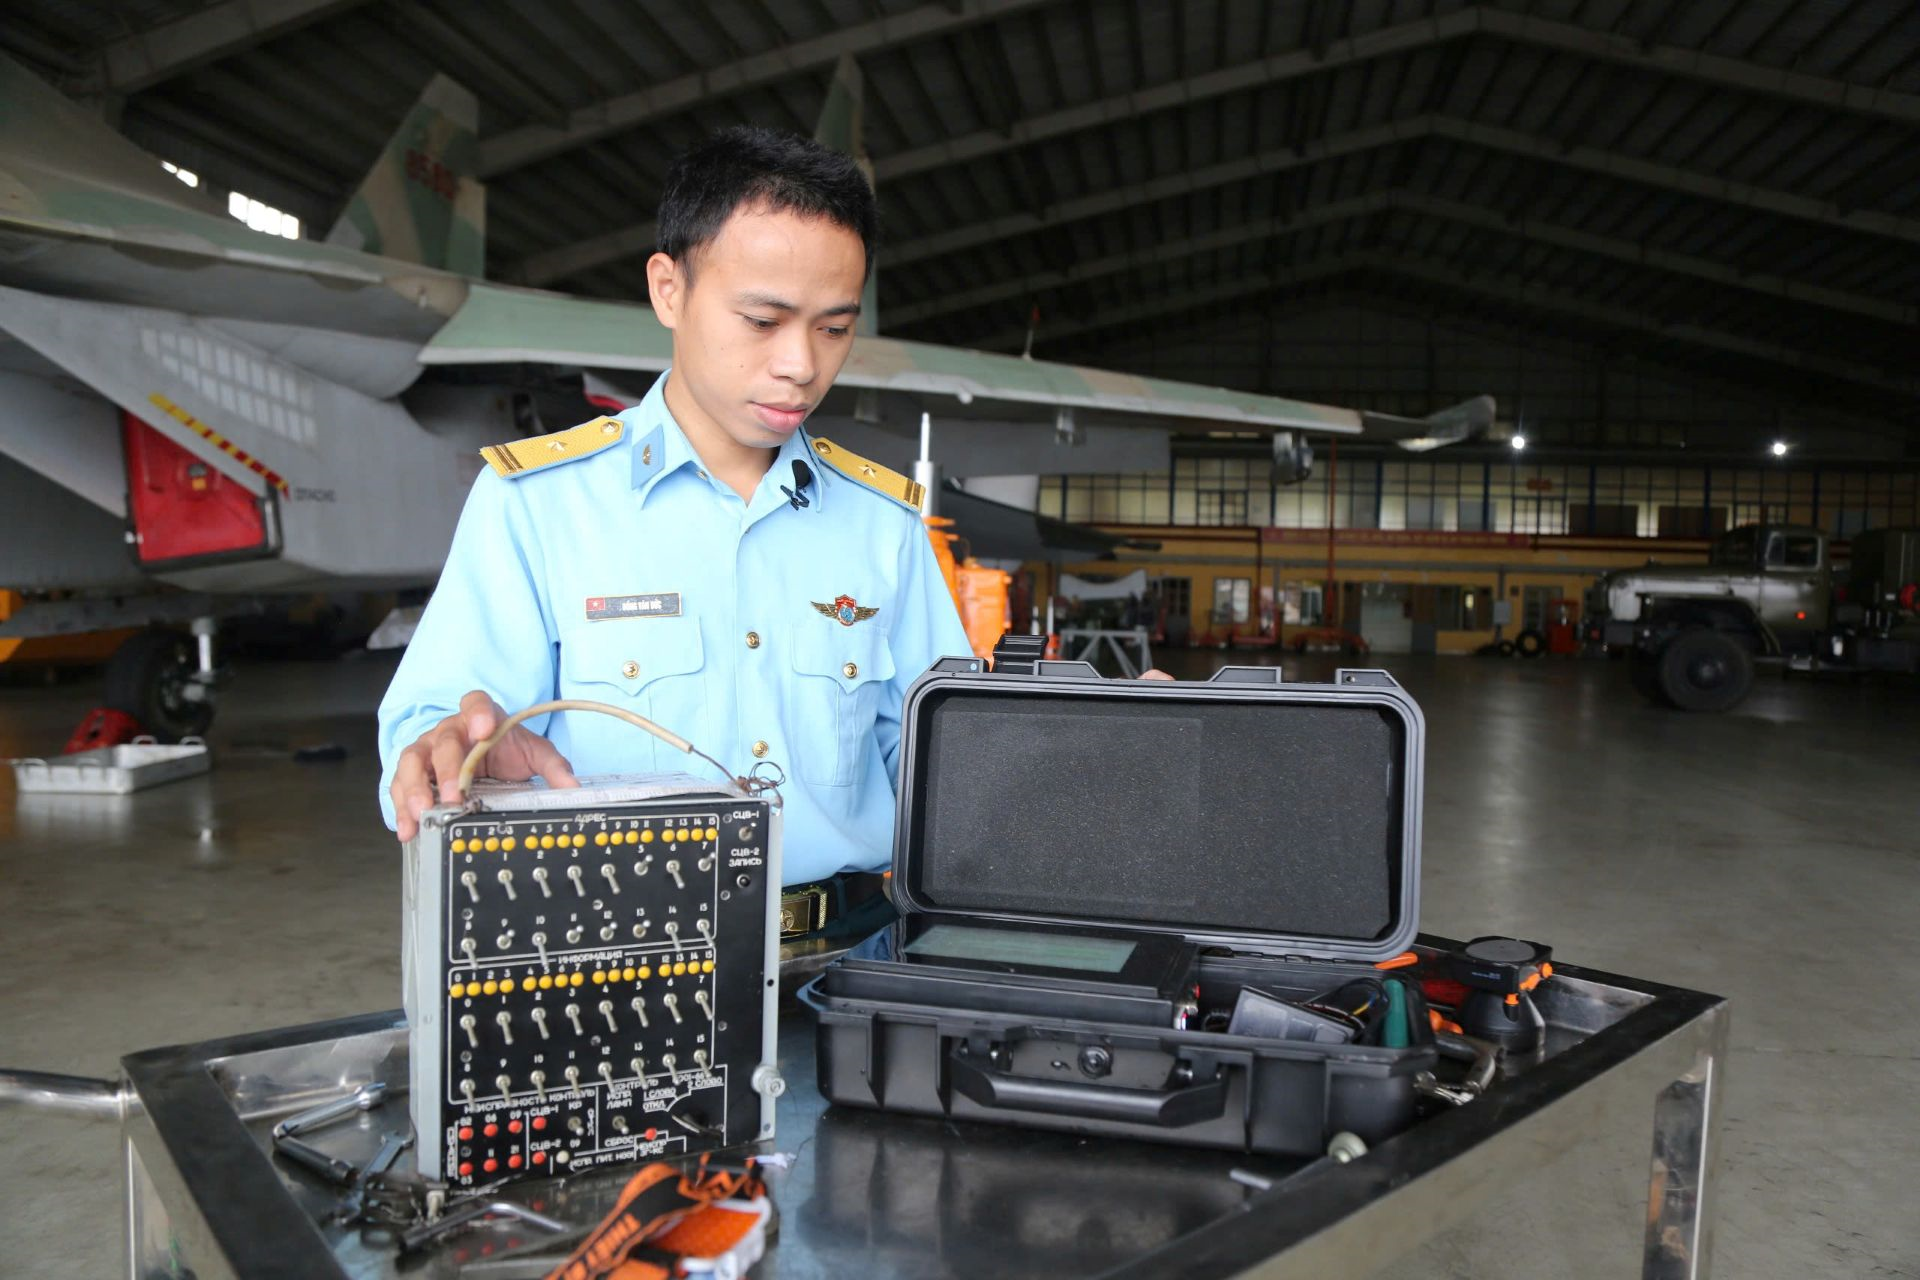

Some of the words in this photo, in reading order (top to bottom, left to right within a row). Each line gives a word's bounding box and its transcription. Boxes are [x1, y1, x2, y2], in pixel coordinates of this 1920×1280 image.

[574, 813, 607, 823] АДРЕС
[732, 810, 760, 820] СЦВ-1
[455, 826, 462, 837] 0
[473, 827, 478, 836] 1
[488, 826, 495, 835] 2
[506, 825, 514, 835] 3
[530, 824, 537, 834] 4
[546, 824, 552, 833] 5
[562, 824, 569, 832] 6
[578, 823, 584, 832] 7
[600, 822, 607, 830] 8
[616, 820, 621, 828] 9
[630, 820, 638, 828] 10
[644, 819, 650, 828] 11
[665, 818, 673, 827] 12
[679, 818, 688, 826] 13
[694, 818, 702, 826] 14
[708, 816, 716, 825] 15
[466, 853, 473, 863] 0
[504, 852, 508, 862] 1
[537, 850, 544, 860] 2
[571, 848, 578, 858] 3
[605, 846, 612, 855] 4
[638, 844, 644, 854] 5
[670, 843, 676, 852] 6
[702, 841, 708, 850] 7
[730, 847, 760, 857] СЦВ-2
[728, 858, 762, 868] ЗАПИСЬ
[501, 918, 508, 928] 9
[536, 915, 546, 925] 10
[570, 913, 577, 922] 11
[604, 910, 612, 920] 12
[636, 908, 645, 916] 13
[668, 906, 677, 914] 14
[700, 903, 708, 912] 15
[454, 973, 462, 982] 0
[472, 971, 476, 980] 1
[488, 970, 494, 979] 2
[504, 968, 511, 978] 3
[527, 967, 534, 976] 4
[558, 964, 566, 972] 6
[576, 962, 582, 971] 7
[596, 960, 602, 969] 8
[612, 959, 618, 968] 9
[625, 958, 634, 966] 10
[641, 956, 648, 965] 11
[661, 954, 670, 964] 12
[676, 953, 684, 962] 13
[690, 952, 699, 960] 14
[705, 950, 712, 959] 15
[464, 998, 472, 1008] 0
[502, 995, 506, 1004] 1
[534, 991, 542, 1000] 2
[568, 988, 576, 997] 3
[602, 984, 609, 994] 4
[636, 981, 642, 990] 5
[667, 978, 674, 987] 6
[698, 975, 705, 984] 7
[464, 1062, 471, 1072] 8
[500, 1058, 507, 1068] 9
[534, 1054, 544, 1064] 10
[568, 1050, 576, 1060] 11
[602, 1046, 610, 1055] 12
[634, 1042, 643, 1051] 13
[666, 1038, 674, 1047] 14
[696, 1034, 705, 1043] 15
[613, 1078, 659, 1090] КОНТРЛЬ
[530, 1104, 559, 1117] СЦВ-1
[568, 1100, 582, 1110] КР
[530, 1138, 562, 1152] СЦВ-2
[604, 1135, 634, 1148] СБРОС
